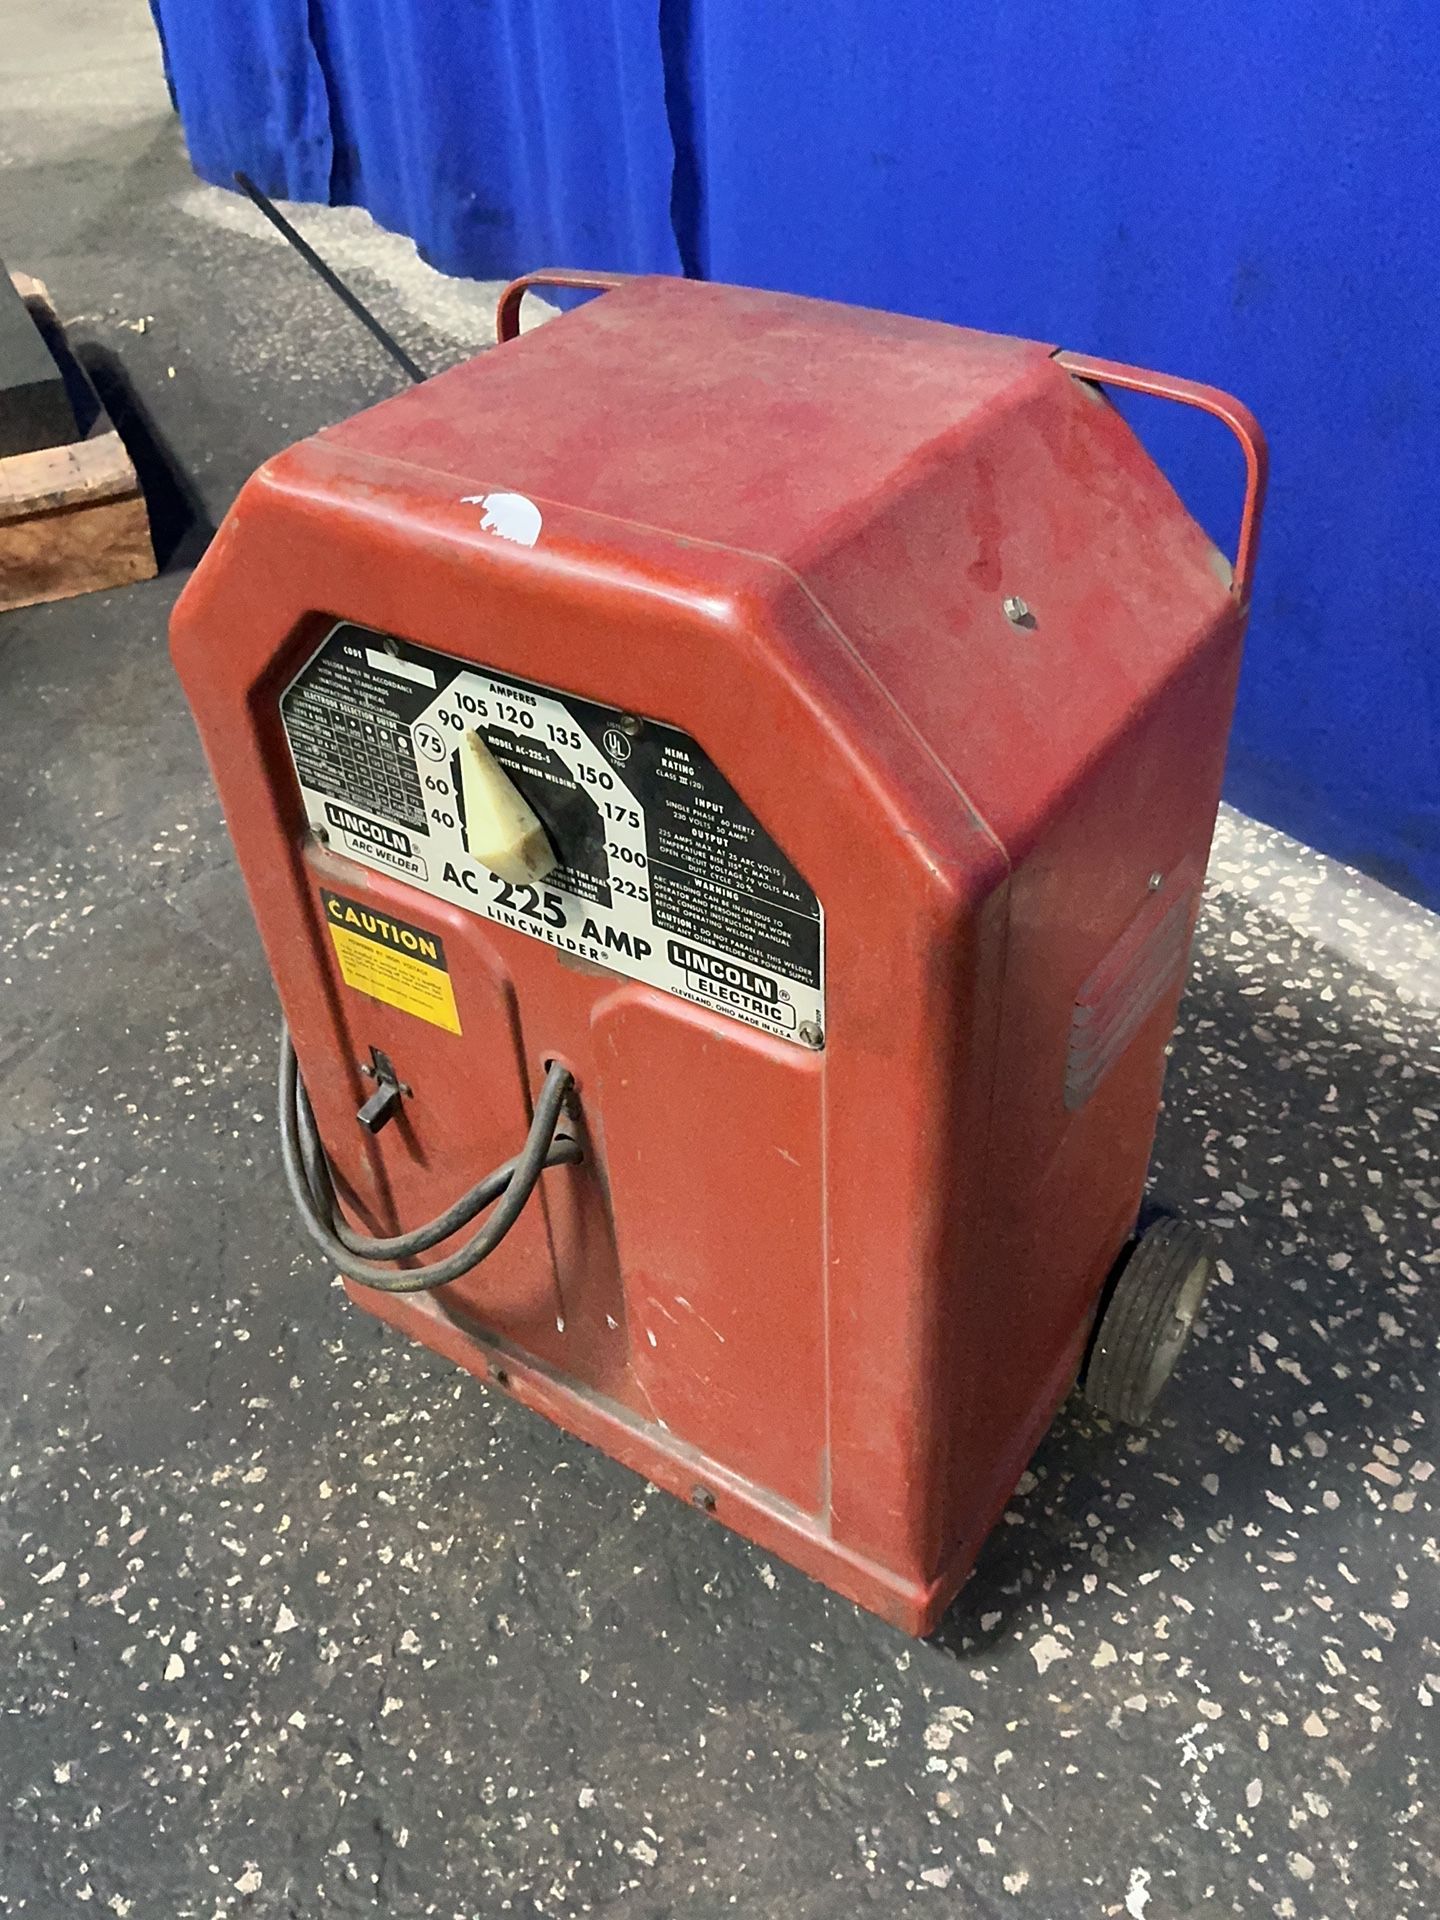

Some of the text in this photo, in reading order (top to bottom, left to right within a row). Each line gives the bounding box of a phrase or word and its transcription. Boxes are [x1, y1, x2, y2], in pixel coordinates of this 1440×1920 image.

[344, 646, 362, 659] CODE
[454, 692, 488, 717] 105
[489, 683, 537, 706] AMPERES
[438, 709, 464, 731] 90
[496, 702, 534, 729] 120
[419, 732, 442, 753] 75
[488, 735, 513, 751] MODEL
[547, 724, 582, 750] 135
[608, 733, 626, 757] UL
[661, 757, 695, 776] RATING
[664, 747, 690, 762] NEMA
[425, 775, 449, 795] 60
[521, 764, 543, 778] WHEN
[544, 772, 576, 790] WELDING
[577, 763, 614, 790] 150
[655, 769, 677, 781] CLASS
[689, 781, 705, 791] (20)
[431, 809, 455, 828] 40
[604, 802, 640, 828] 175
[665, 800, 756, 836] SINGLE PHASE 60 HERTZ
[694, 797, 724, 814] INPUT
[673, 811, 748, 842] 230 VOLTS 50 AMPS
[691, 828, 729, 847] OUTPUT
[351, 839, 419, 873] ARC WELDER
[608, 843, 647, 868] 200
[658, 828, 671, 838] 225
[673, 834, 693, 845] AMPS
[716, 849, 726, 857] AT
[728, 852, 738, 861] 25
[740, 857, 755, 868] ARC
[757, 863, 780, 876] VOLTS
[659, 836, 707, 859] TEMPERATURE
[709, 854, 724, 866] RISE
[576, 870, 589, 881] THE
[591, 876, 607, 888] DIAL
[659, 845, 679, 858] OPEN
[680, 853, 707, 868] CIRCUIT
[709, 863, 743, 881] VOLTAGE
[745, 876, 755, 885] 79
[757, 880, 780, 894] VOLTS
[688, 864, 707, 875] DUTY
[710, 872, 731, 885] CYCLE
[577, 879, 598, 893] THESE
[612, 877, 649, 902] 225
[694, 878, 739, 901] WARNING
[442, 862, 652, 961] AC 225 AMP
[653, 875, 667, 884] ARC
[669, 880, 701, 897] WELDING
[703, 893, 719, 903] CAN
[732, 904, 771, 923] INJURIOUS
[773, 919, 783, 927] TO
[653, 882, 690, 901] OPERATOR
[692, 897, 708, 907] AND
[710, 904, 741, 920] PERSONS
[754, 920, 767, 930] THE
[769, 926, 792, 940] WORK
[328, 899, 438, 960] CAUTION
[655, 899, 754, 941] BEFORE OPERATING WELDER
[677, 900, 708, 915] CONSULT
[710, 911, 756, 934] INSTRUCTION
[758, 930, 790, 947] MANUAL
[657, 920, 814, 984] WITH ANY OTHER WELDER OR POWER SUPPLY
[700, 928, 711, 937] DO
[713, 933, 728, 943] NOT
[730, 939, 764, 958] PARALLEL
[766, 953, 782, 964] THIS
[783, 960, 813, 976] WELDER
[698, 978, 782, 1021] ELECTRIC
[715, 1004, 736, 1016] OHIO
[738, 1014, 760, 1027] MADE
[761, 1023, 770, 1031] IN
